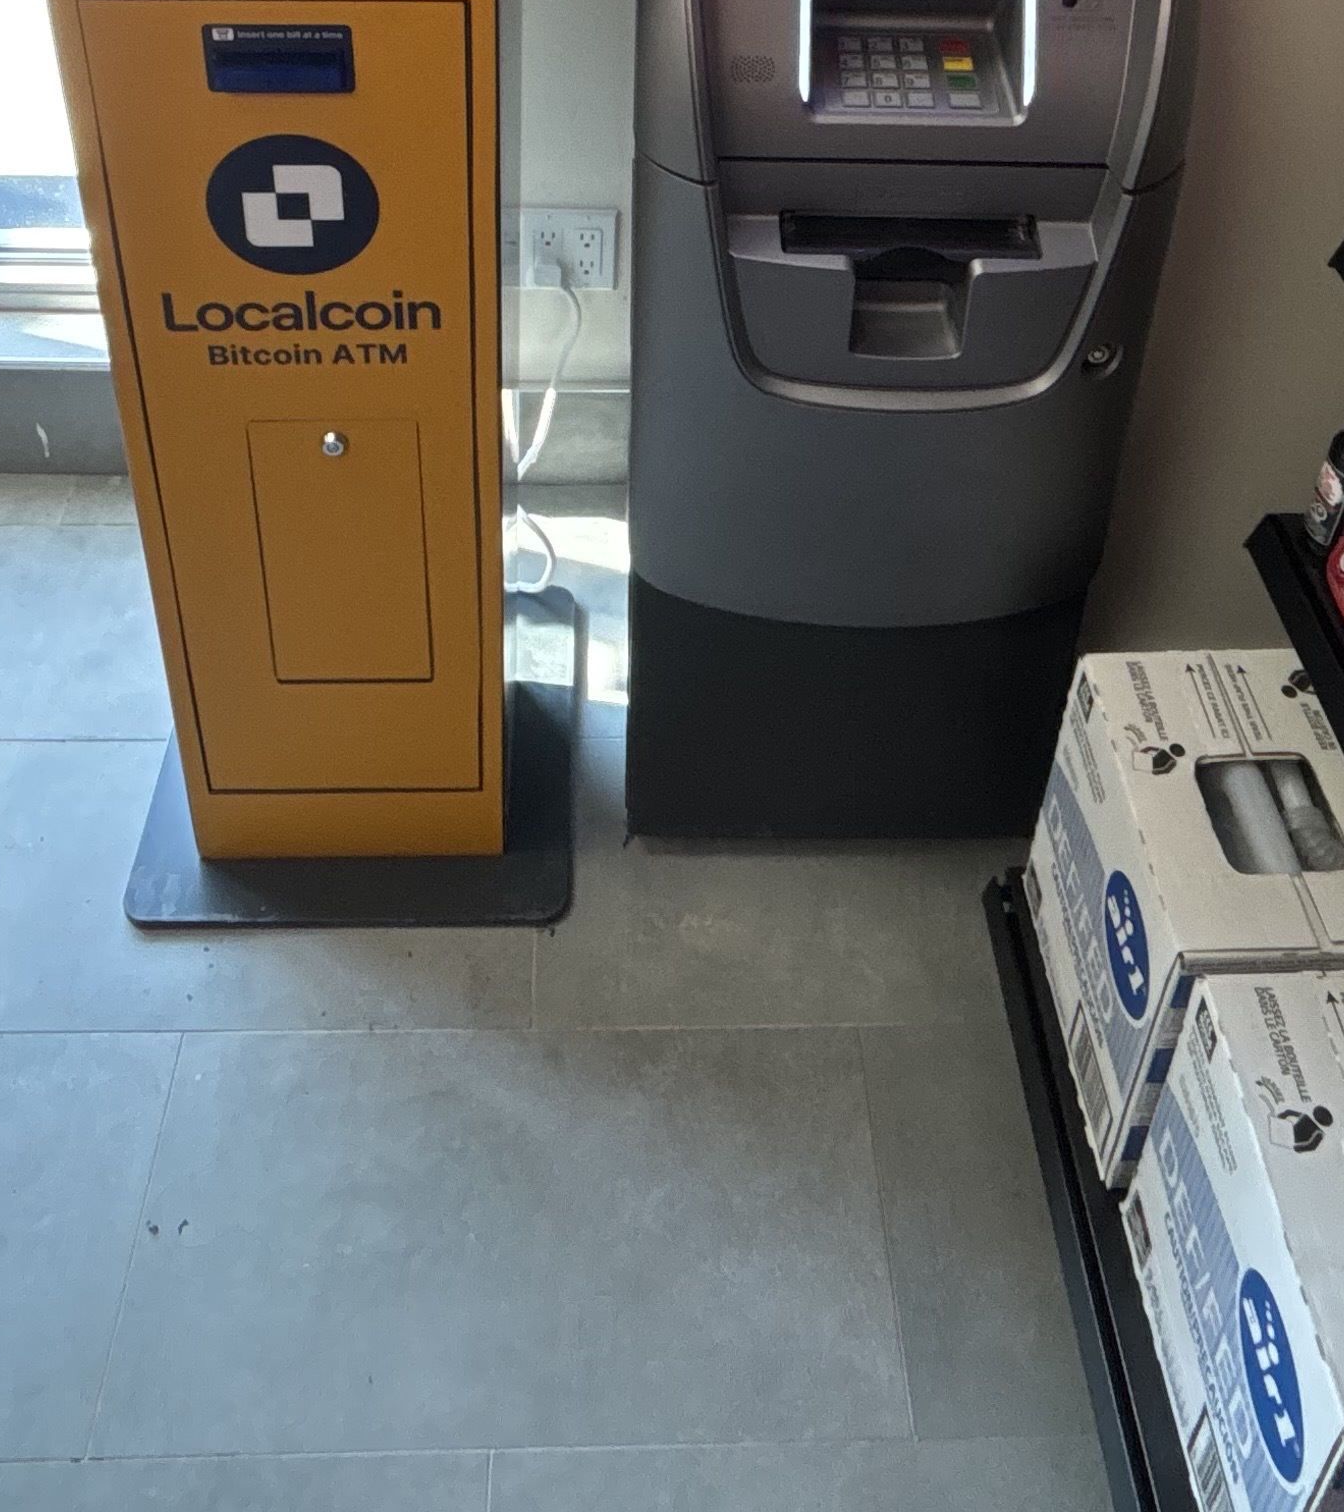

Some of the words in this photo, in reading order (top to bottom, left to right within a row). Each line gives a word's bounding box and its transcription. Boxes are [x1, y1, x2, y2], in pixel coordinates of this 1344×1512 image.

[237, 30, 265, 40] Insert
[266, 31, 285, 40] one
[287, 30, 301, 40] bill
[322, 31, 343, 40] time
[161, 290, 441, 333] Localcoin
[208, 342, 322, 366] Bitcoin
[332, 343, 408, 364] ATM
[1253, 985, 1271, 1017] DANS
[1268, 1030, 1291, 1076] CARTON
[1263, 985, 1286, 1028] LAISSEZ
[1283, 1043, 1312, 1104] BOUTEILLE
[1159, 1141, 1253, 1459] DEF/FED
[1243, 1298, 1296, 1447] air1
